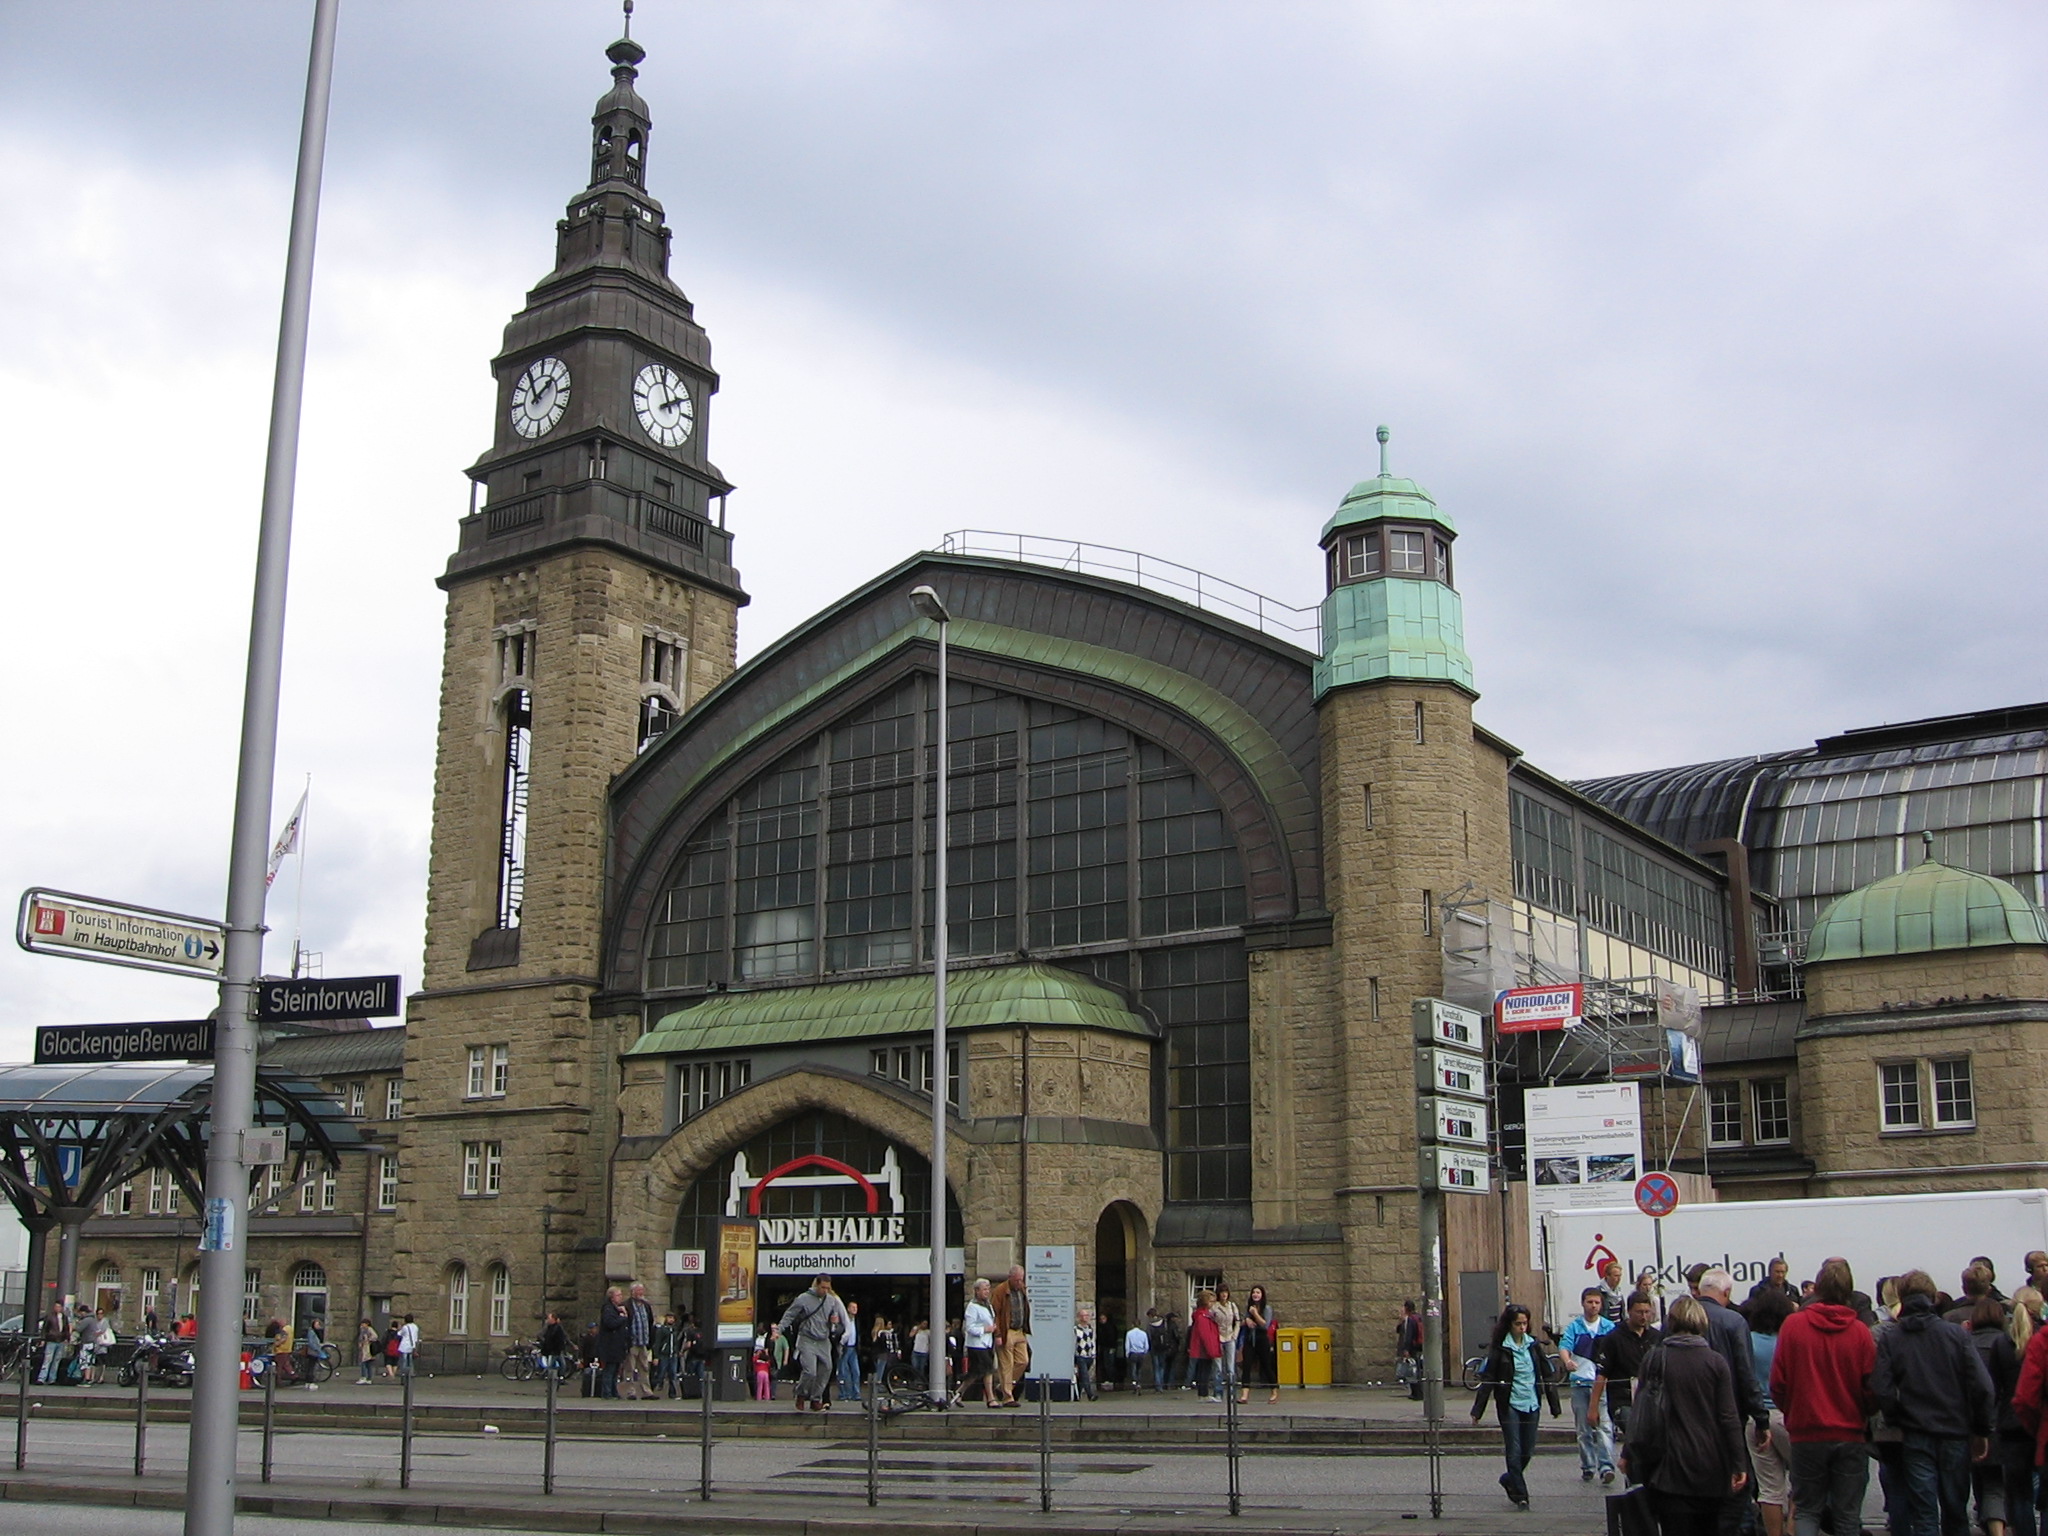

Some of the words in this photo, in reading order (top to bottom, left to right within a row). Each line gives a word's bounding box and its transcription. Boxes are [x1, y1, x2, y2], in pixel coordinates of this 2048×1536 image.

[68, 910, 111, 930] Tourist
[116, 920, 184, 942] Information
[74, 928, 89, 943] im
[94, 932, 177, 957] Hauptbahnhof
[269, 982, 387, 1013] Steintorwall
[1505, 992, 1570, 1009] NORDDACH
[41, 1025, 208, 1060] Glockengießerwall
[757, 1217, 905, 1244] NDELHALLE
[684, 1256, 697, 1268] DB
[769, 1254, 856, 1271] Hauptbahnhof
[1628, 1251, 1785, 1286] Lekklan
